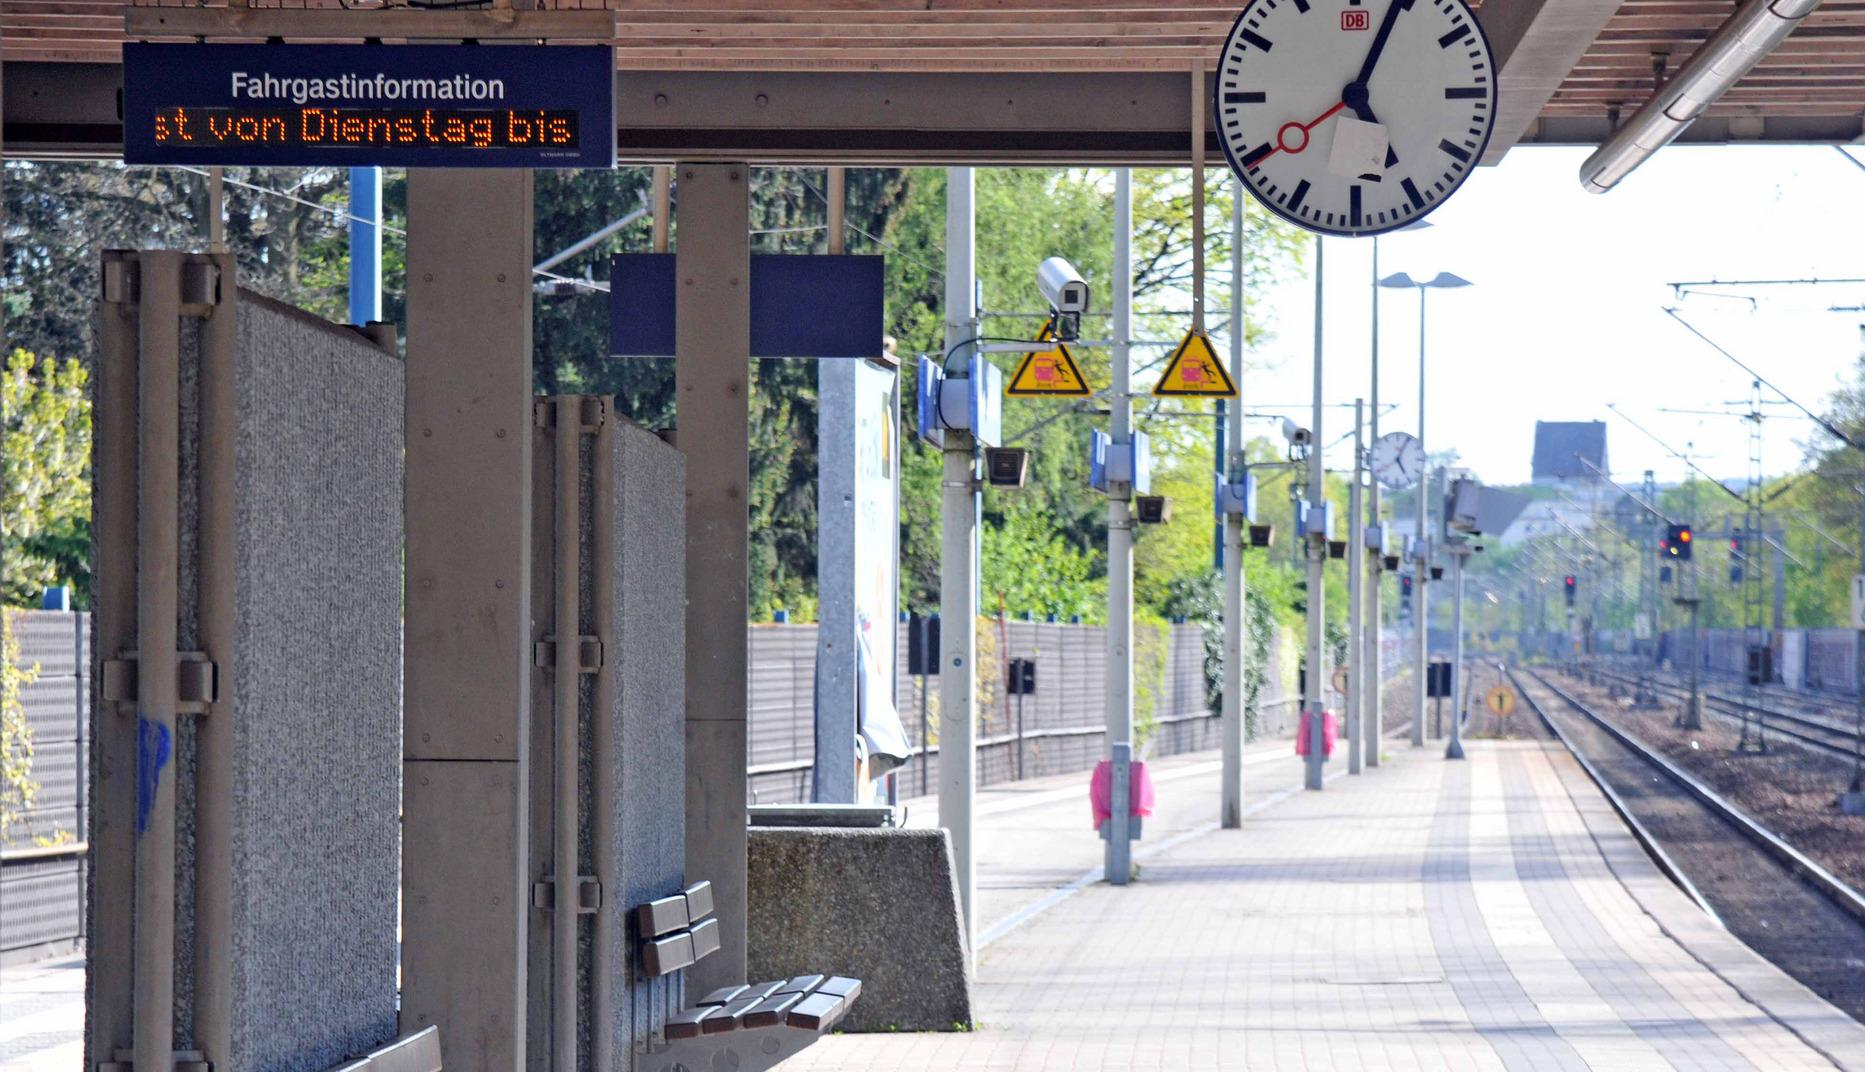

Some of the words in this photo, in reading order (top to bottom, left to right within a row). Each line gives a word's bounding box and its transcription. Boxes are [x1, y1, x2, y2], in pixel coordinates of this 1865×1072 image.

[1345, 14, 1364, 27] DB
[231, 72, 504, 104] Fahrgastinformation
[155, 107, 193, 141] st
[209, 117, 286, 141] von
[302, 108, 492, 147] Dienstag
[508, 109, 571, 142] bis
